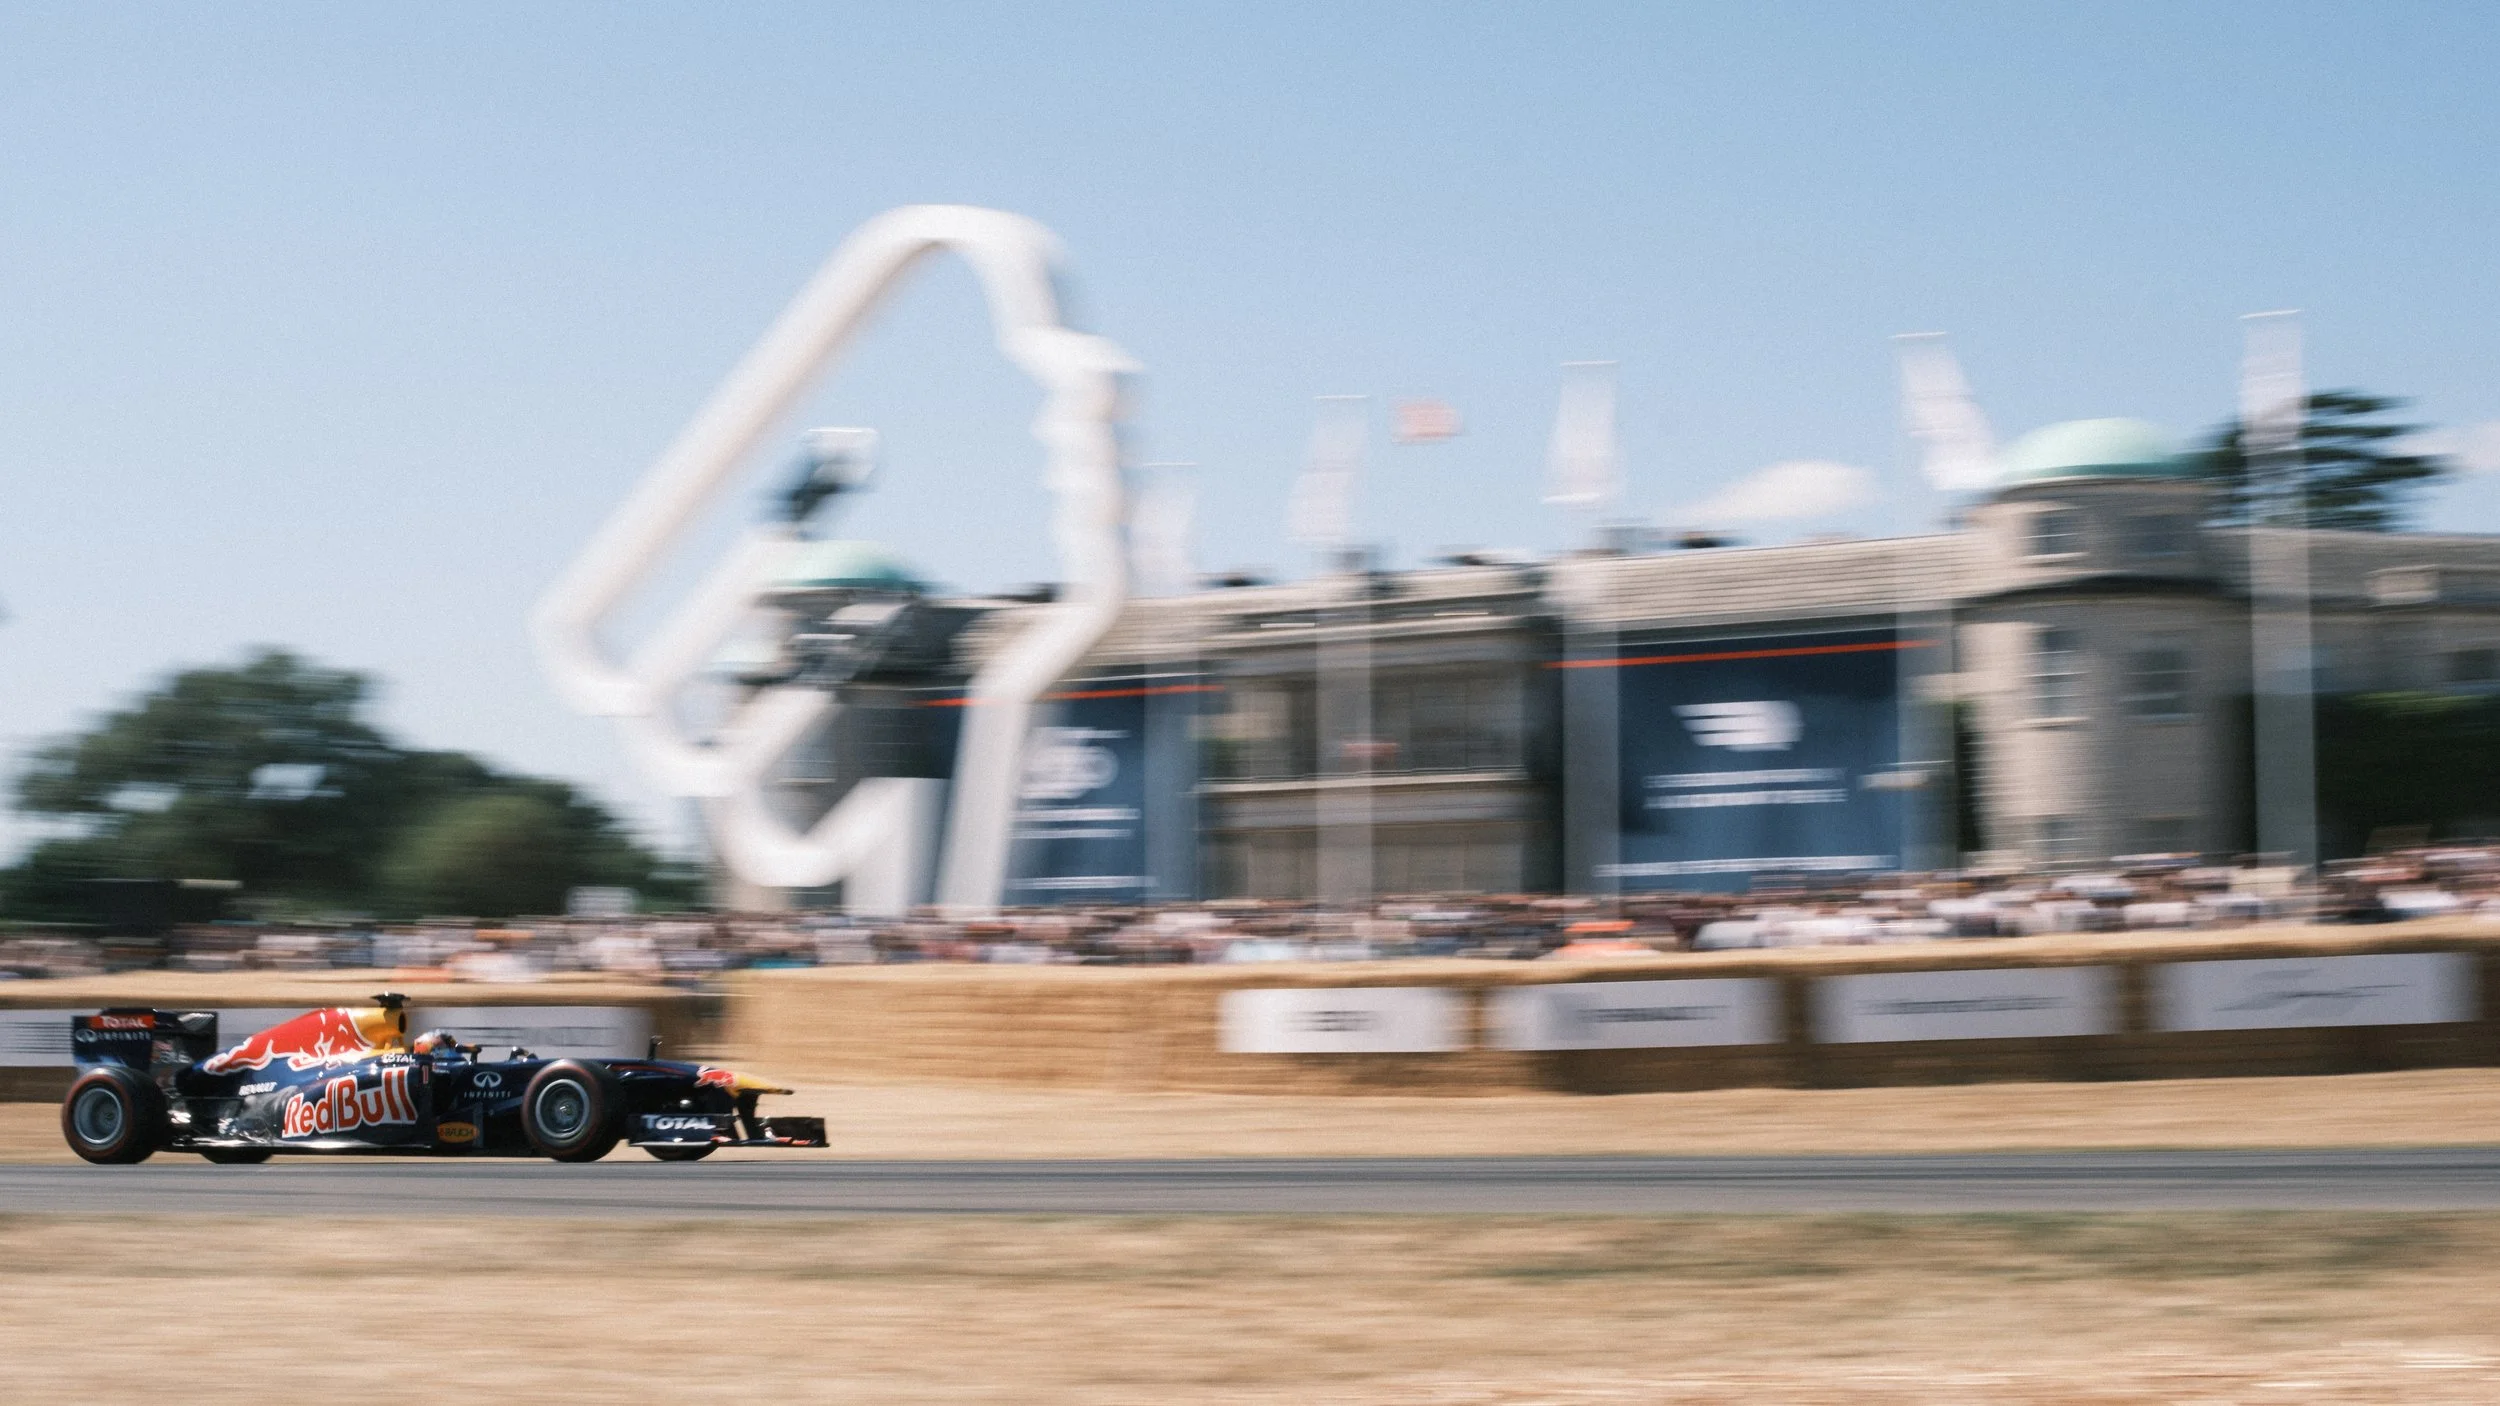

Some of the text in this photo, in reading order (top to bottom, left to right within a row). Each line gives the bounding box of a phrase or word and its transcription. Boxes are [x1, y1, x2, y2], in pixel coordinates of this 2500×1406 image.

[102, 1016, 148, 1028] TOTAL
[382, 1053, 415, 1063] TOTAL
[641, 1115, 716, 1130] TOTAL
